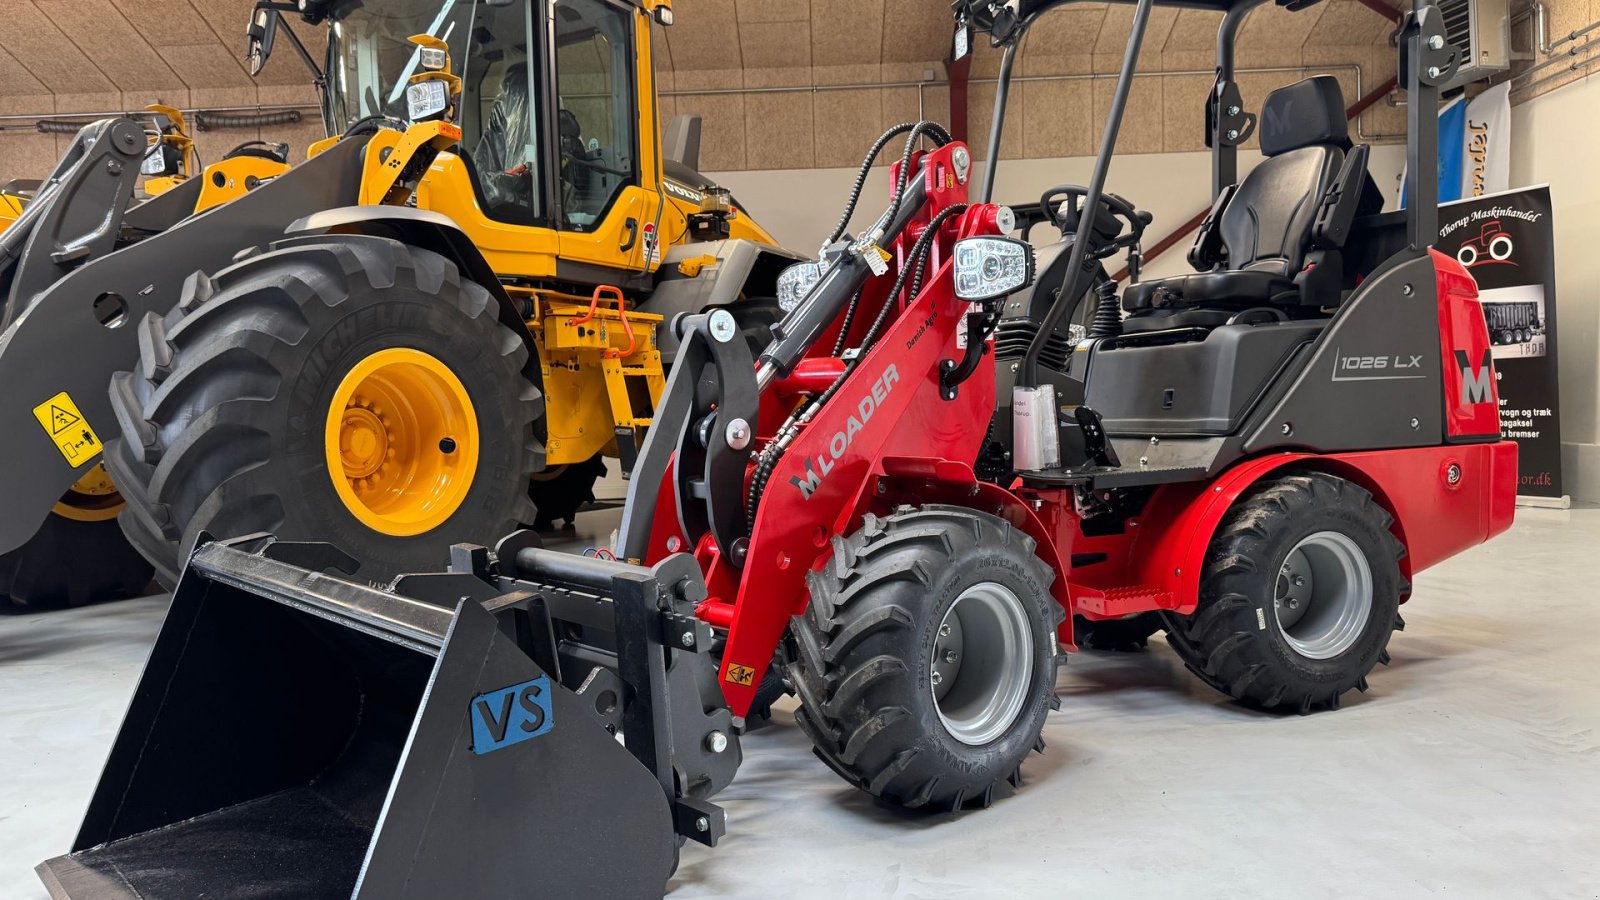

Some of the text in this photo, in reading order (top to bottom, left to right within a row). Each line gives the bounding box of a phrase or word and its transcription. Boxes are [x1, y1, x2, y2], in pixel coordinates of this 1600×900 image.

[663, 181, 703, 202] VOLV
[1440, 206, 1542, 238] Thorup Maskinhandel
[906, 311, 938, 350] Danish Agro
[1519, 342, 1545, 356] THOR
[1341, 355, 1423, 370] 1026 LX
[817, 363, 900, 477] LOADER
[1521, 410, 1532, 418] og
[1533, 408, 1552, 417] træk
[1508, 430, 1540, 438] bremser
[1517, 471, 1552, 486] or.dk
[475, 685, 545, 743] VS
